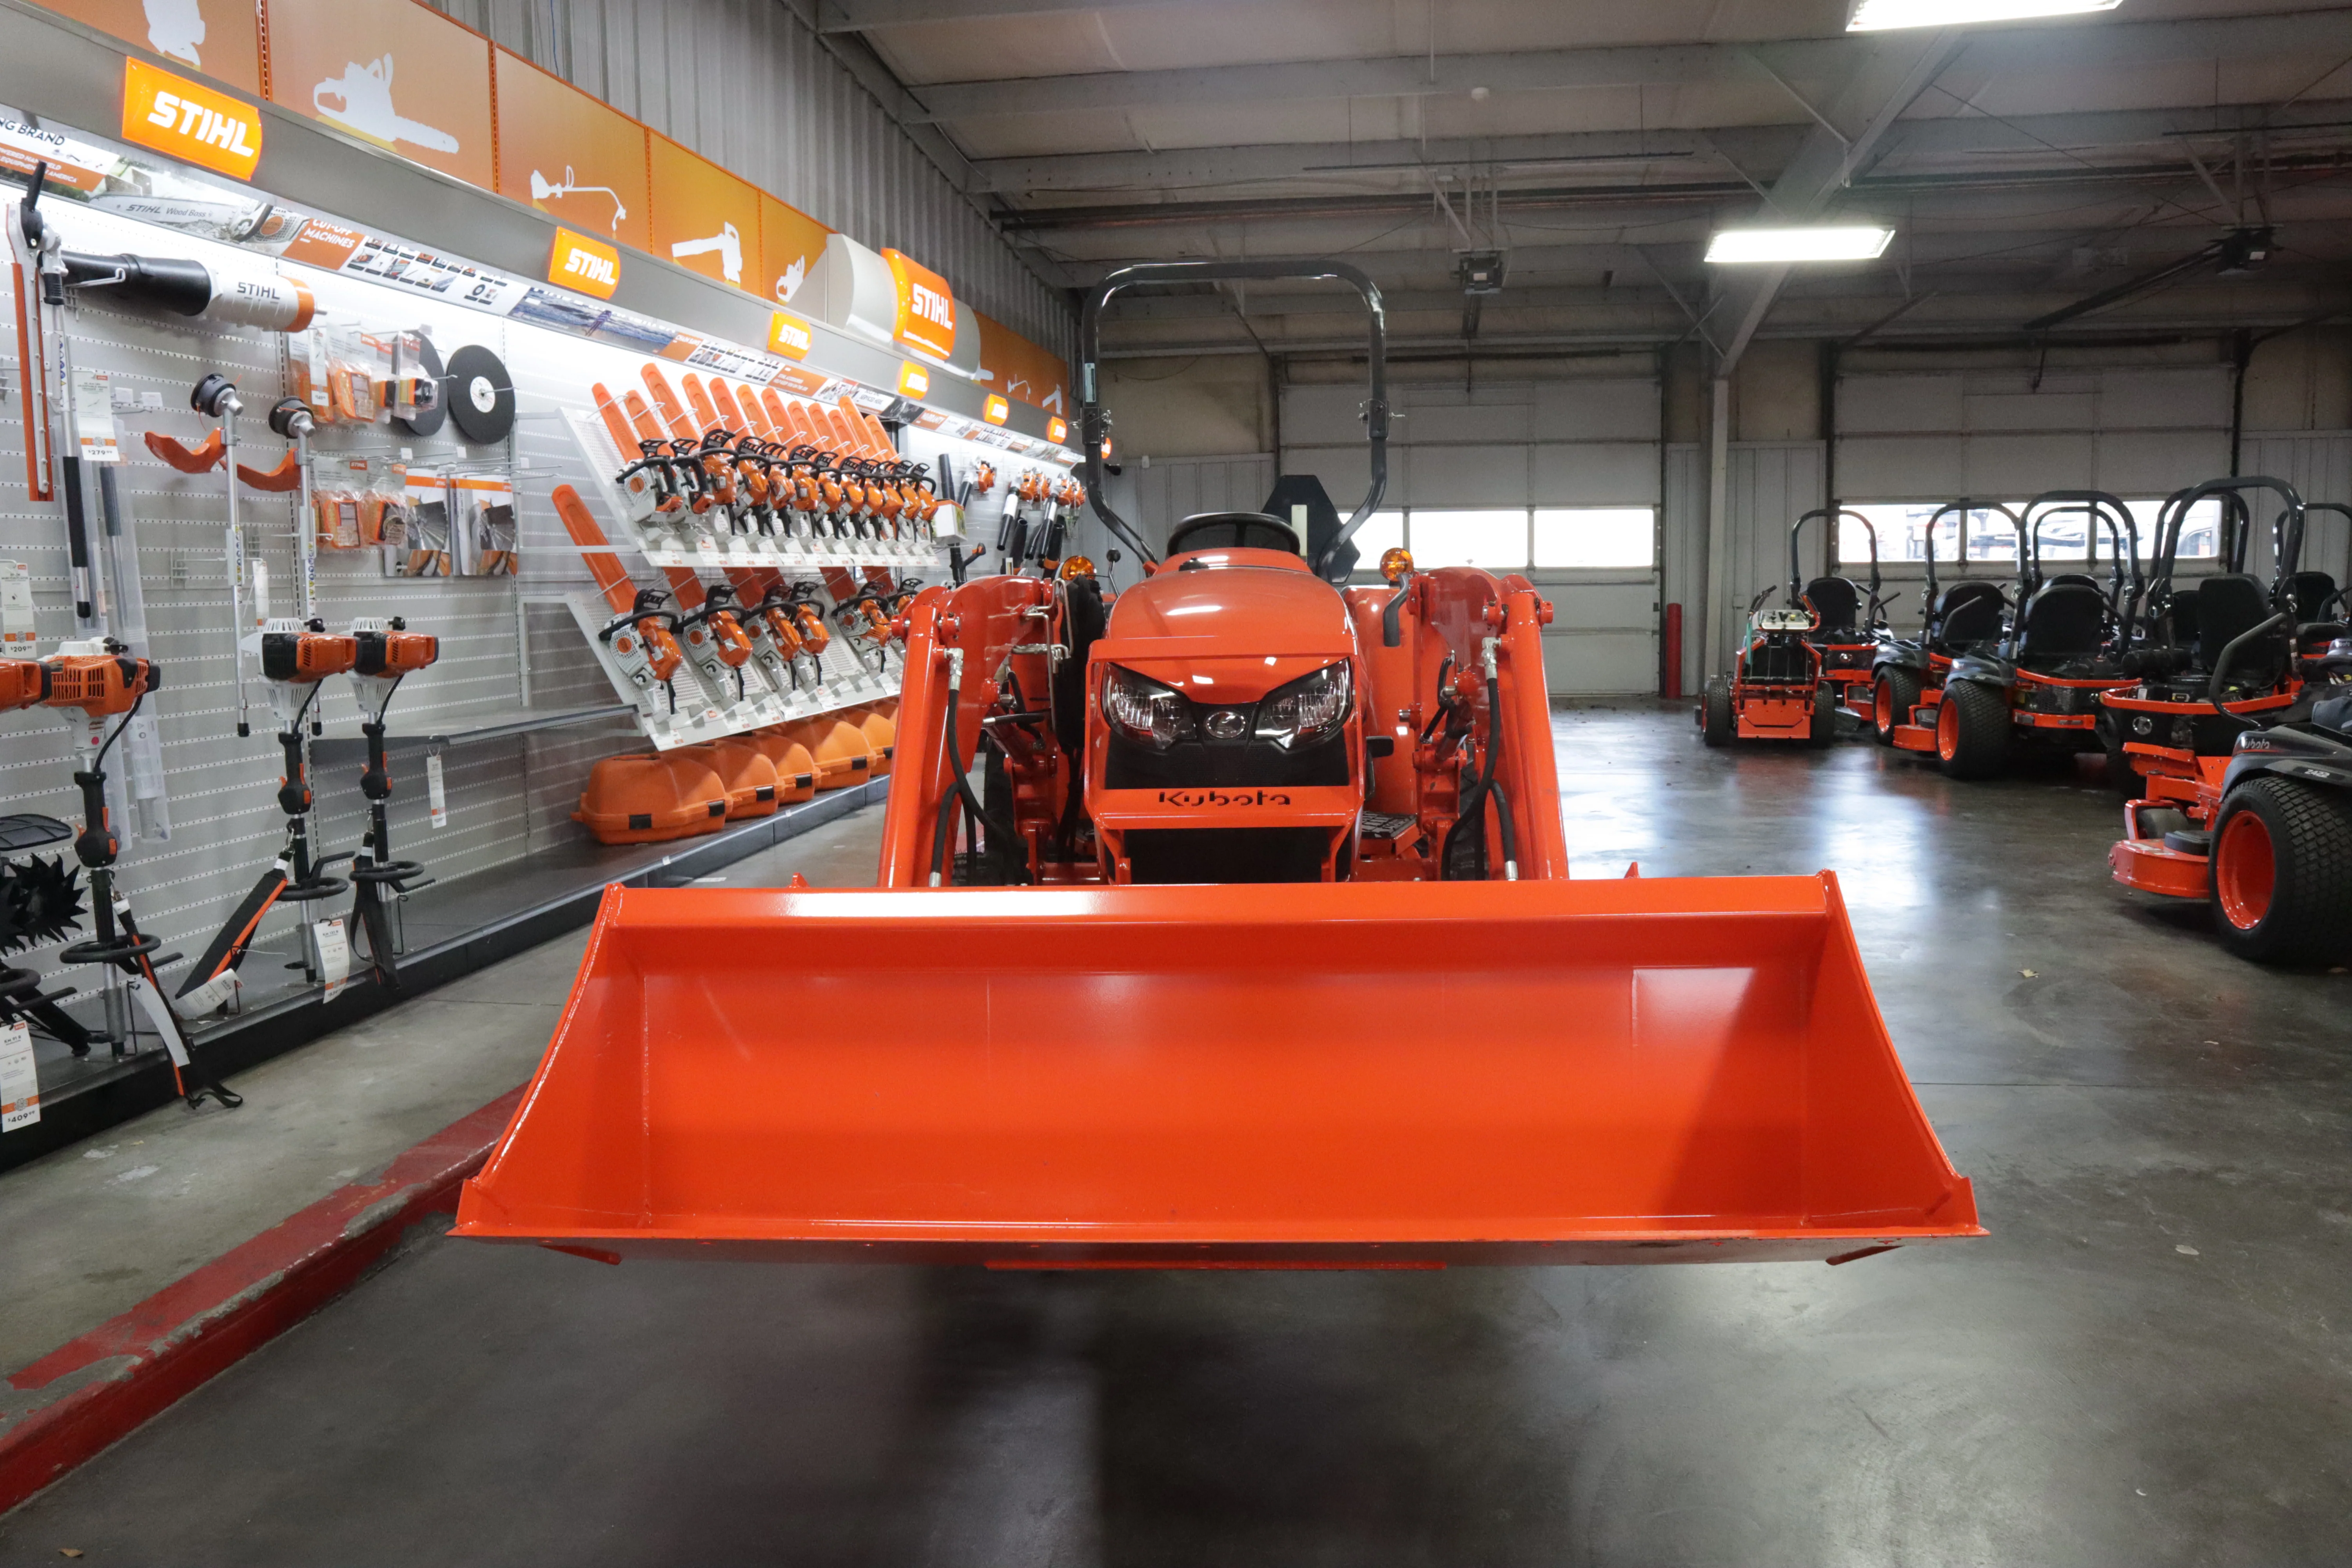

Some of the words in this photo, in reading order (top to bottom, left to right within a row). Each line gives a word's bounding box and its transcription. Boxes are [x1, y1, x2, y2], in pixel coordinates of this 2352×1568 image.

[147, 91, 254, 157] STIHL
[18, 125, 65, 145] BRAND
[47, 171, 77, 183] AMERICA
[126, 204, 162, 214] STIHL
[166, 207, 189, 216] Wood
[304, 228, 355, 248] MACHINES
[564, 248, 617, 285] STIHL
[237, 282, 280, 299] STIHL
[911, 283, 953, 330] STIHL
[2241, 738, 2270, 749] ubota
[2305, 769, 2330, 778] Z422
[1159, 789, 1290, 806] Kubota
